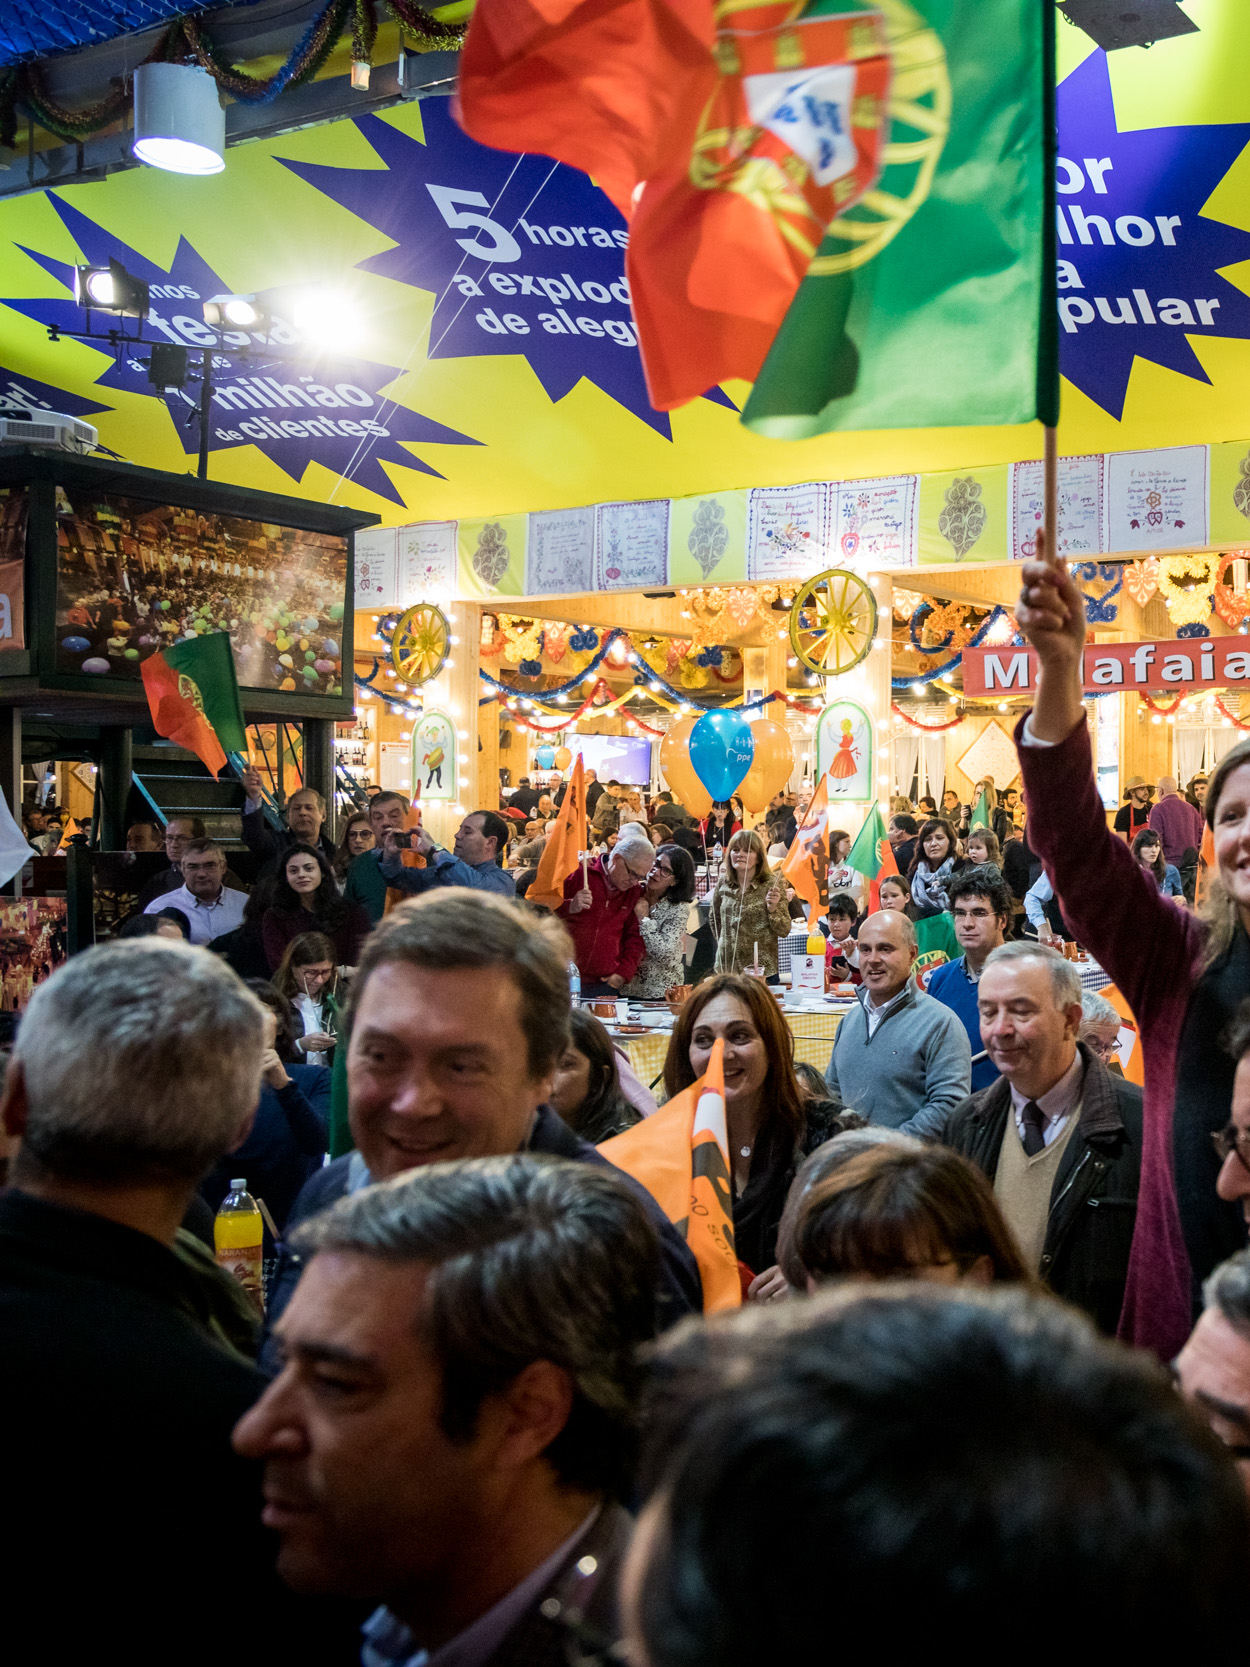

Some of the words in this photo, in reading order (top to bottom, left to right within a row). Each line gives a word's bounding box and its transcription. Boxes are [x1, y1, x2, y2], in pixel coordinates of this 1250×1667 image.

[1057, 156, 1114, 195] or
[425, 183, 522, 263] 5
[518, 218, 630, 250] horas
[1057, 205, 1182, 247] lhor
[454, 274, 486, 297] a
[488, 272, 633, 305] explod
[475, 307, 531, 335] de
[537, 308, 640, 348] aleg
[1057, 288, 1221, 334] pular
[210, 376, 375, 411] milhão
[214, 427, 245, 442] de
[239, 414, 391, 440] clientes
[736, 753, 751, 762] ppe
